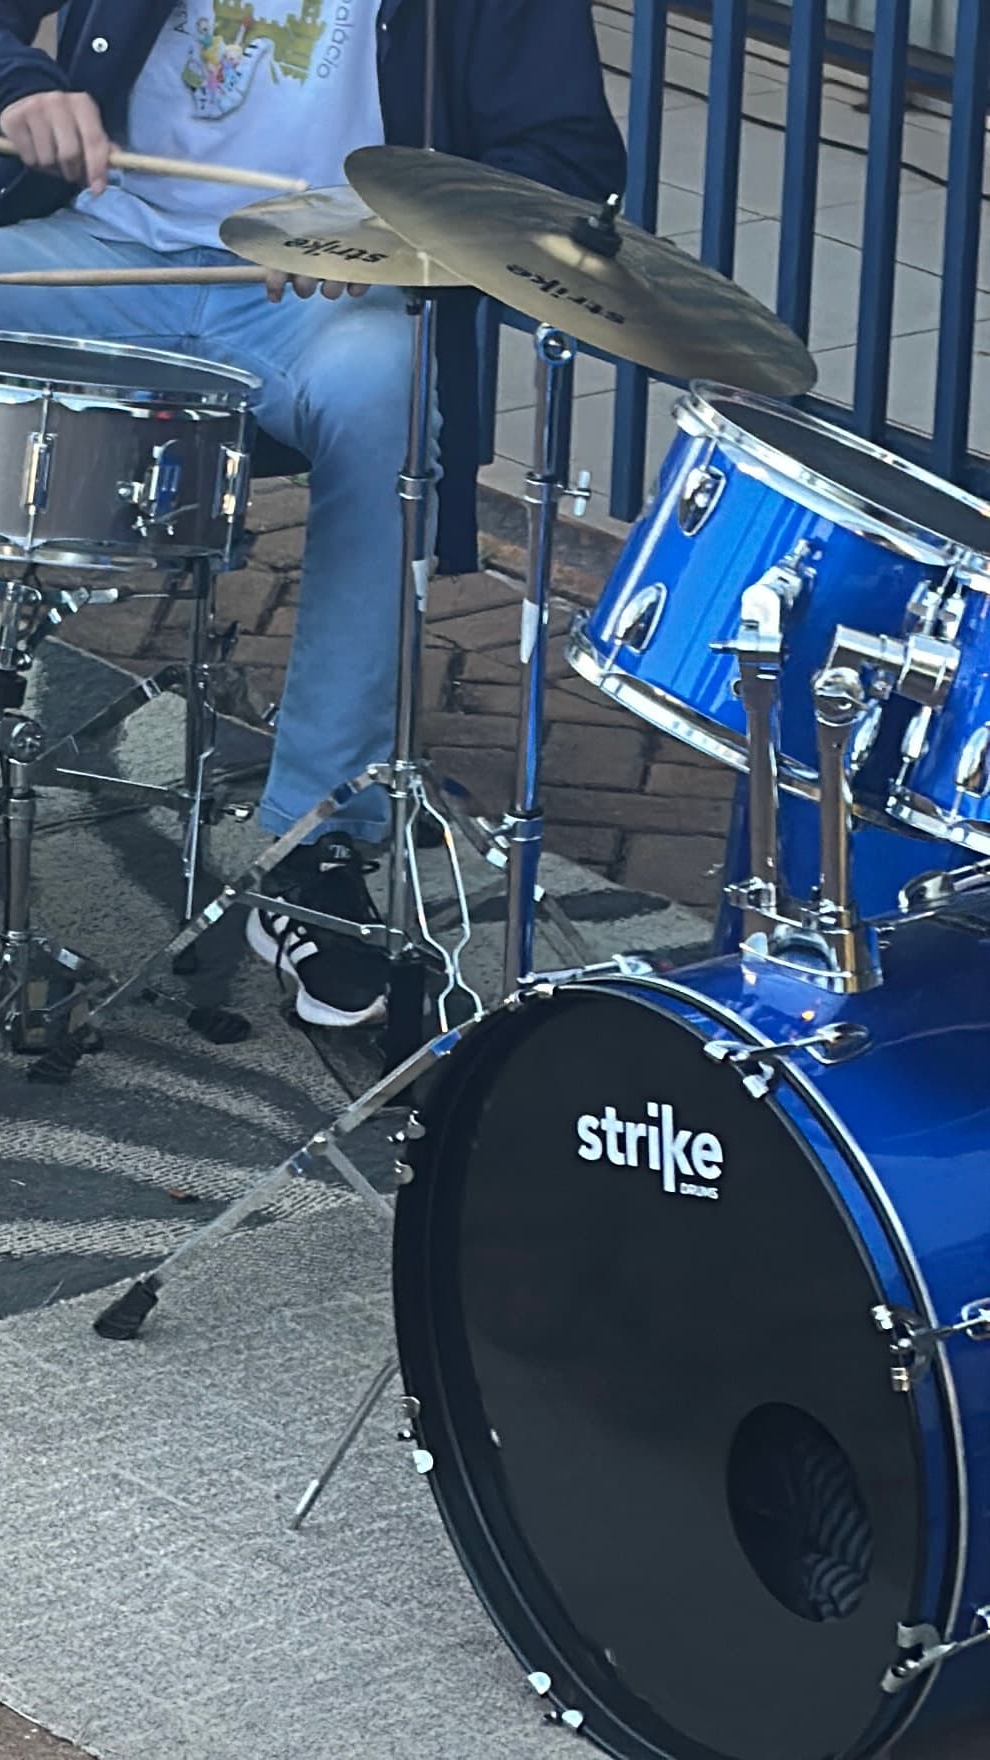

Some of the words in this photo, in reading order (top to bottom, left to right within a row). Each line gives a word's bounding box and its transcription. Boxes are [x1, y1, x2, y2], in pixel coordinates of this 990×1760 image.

[284, 238, 389, 262] strike
[506, 264, 626, 324] strike
[577, 1101, 724, 1193] strike
